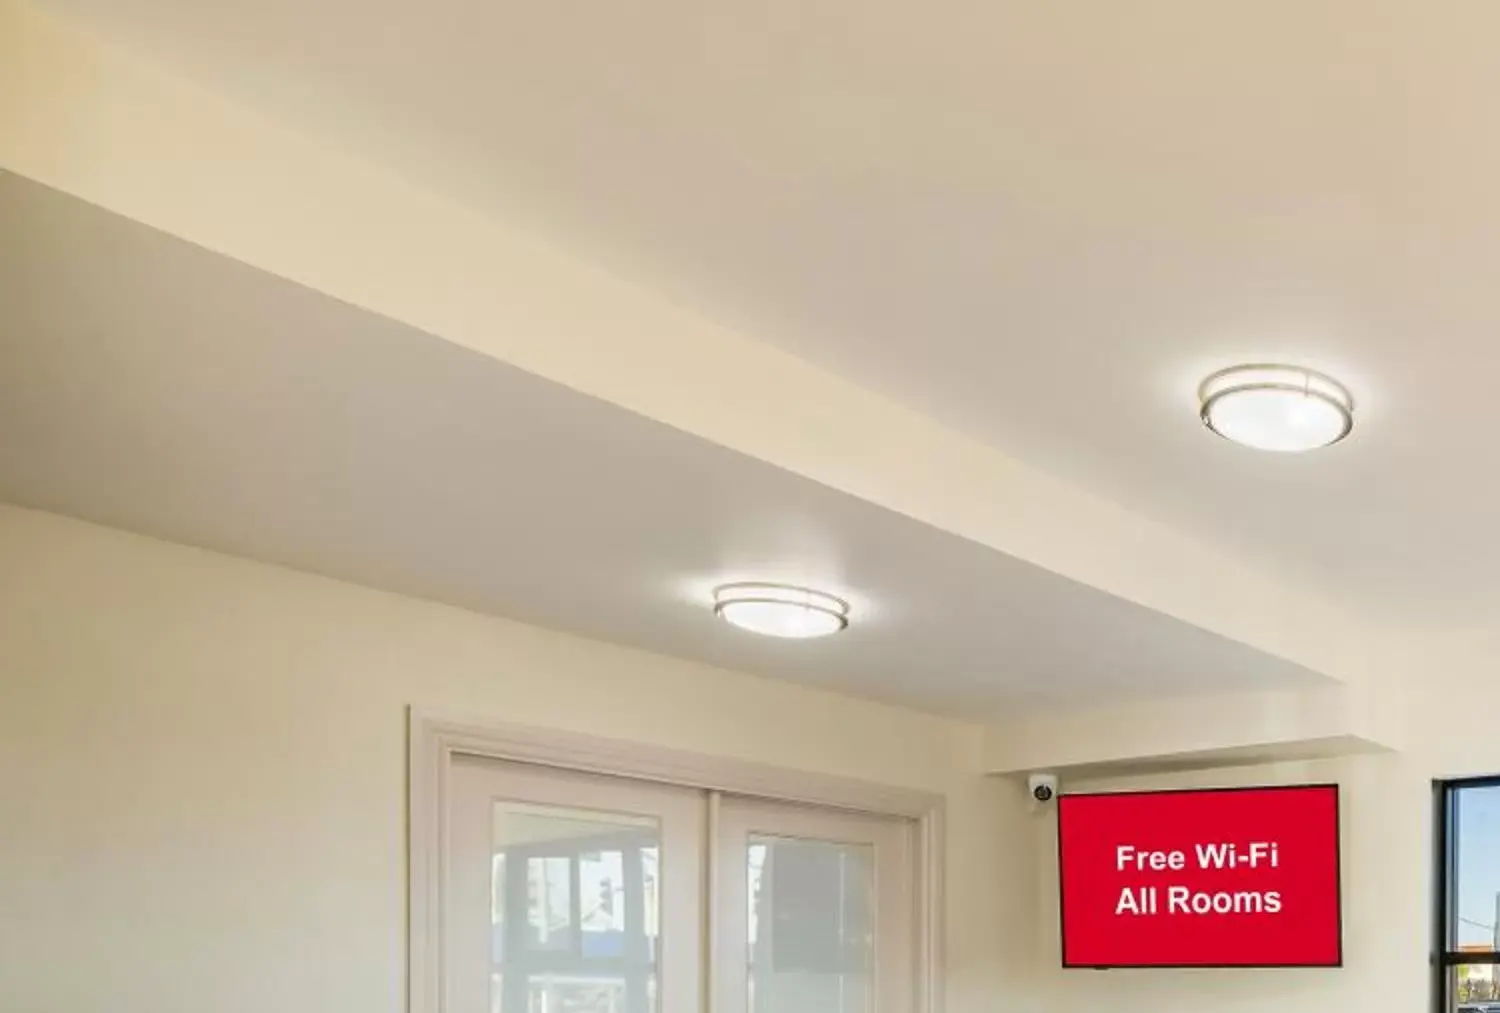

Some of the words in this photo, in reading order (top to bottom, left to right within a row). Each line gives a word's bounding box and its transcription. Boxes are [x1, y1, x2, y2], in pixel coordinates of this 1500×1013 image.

[1116, 844, 1185, 871] Free
[1195, 842, 1279, 870] Wi-Fi
[1115, 887, 1157, 915] All
[1168, 886, 1282, 914] Rooms
